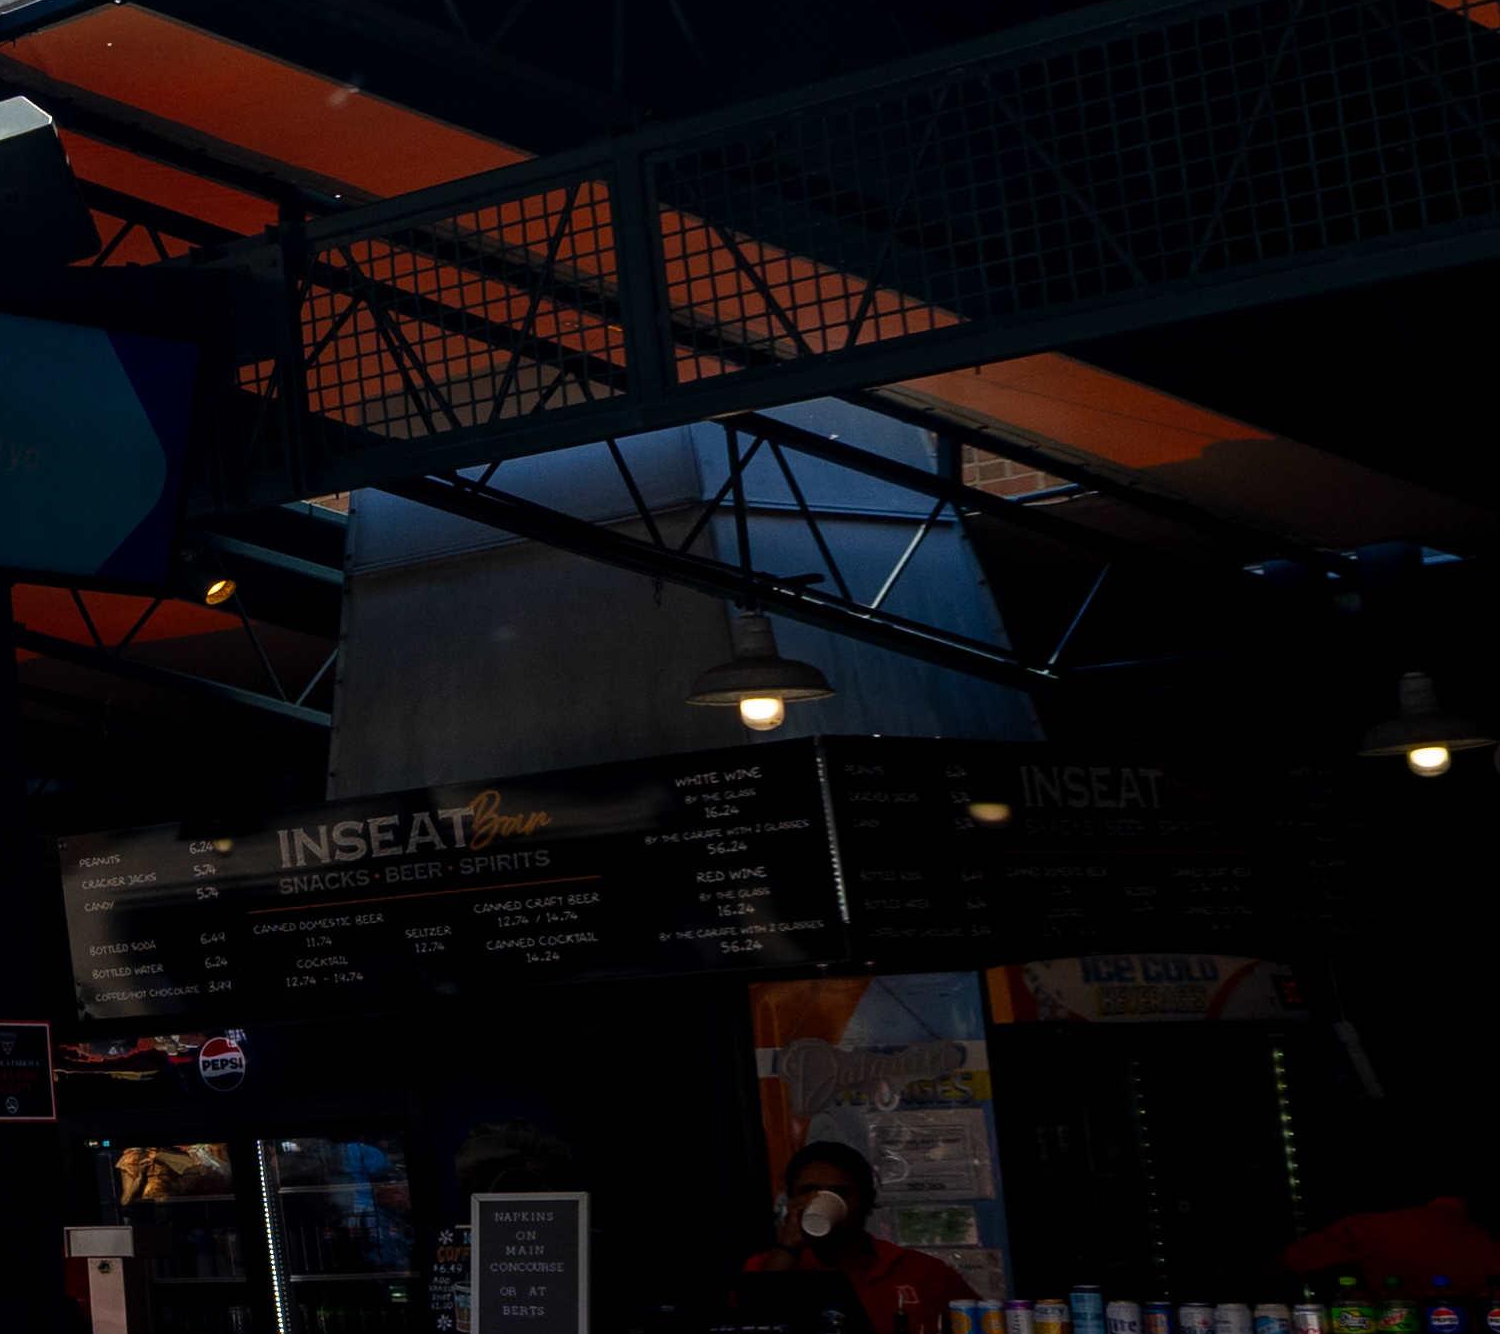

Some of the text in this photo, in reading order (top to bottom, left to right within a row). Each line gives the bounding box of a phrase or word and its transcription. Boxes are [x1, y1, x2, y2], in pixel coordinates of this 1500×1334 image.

[674, 766, 763, 787] WHITE WINE
[1019, 764, 1165, 811] INSEAT
[704, 804, 740, 818] 16.24
[276, 806, 475, 869] INSEAT
[79, 841, 213, 867] PEANUTS 6.24
[707, 840, 748, 855] 56.24
[279, 849, 551, 896] SNACKS BEER SPIRITS
[696, 866, 768, 883] RED WINE
[81, 877, 126, 890] CRACKER
[128, 872, 157, 885] JACKS
[84, 899, 115, 912] CANDY
[473, 891, 601, 914] CANNED CRAFT BEER
[717, 903, 756, 917] 16.24
[253, 912, 385, 935] CANNED DOMESTIC BEER
[497, 914, 530, 928] 12.74
[404, 925, 452, 939] SELTZER
[89, 943, 129, 956] BOTTLED
[200, 932, 226, 945] 6.49
[305, 936, 333, 948] 11.74
[414, 941, 446, 954] 12.74
[486, 931, 599, 951] CANNED COCKTAIL
[720, 939, 763, 954] 56.24
[296, 955, 349, 969] COCKTAIL
[526, 951, 560, 964] 14.24
[92, 956, 228, 980] BOTTLED WATER 6.24
[285, 975, 317, 988] 12.74
[149, 984, 200, 997] CHOCOLATE
[202, 1057, 244, 1071] PEPSI
[494, 1211, 555, 1223] NAPKINS
[515, 1230, 536, 1241] ON
[505, 1245, 545, 1256] MAIN
[489, 1262, 565, 1273] CONCOURSE
[499, 1286, 548, 1297] OR AT
[502, 1305, 546, 1316] BERTS
